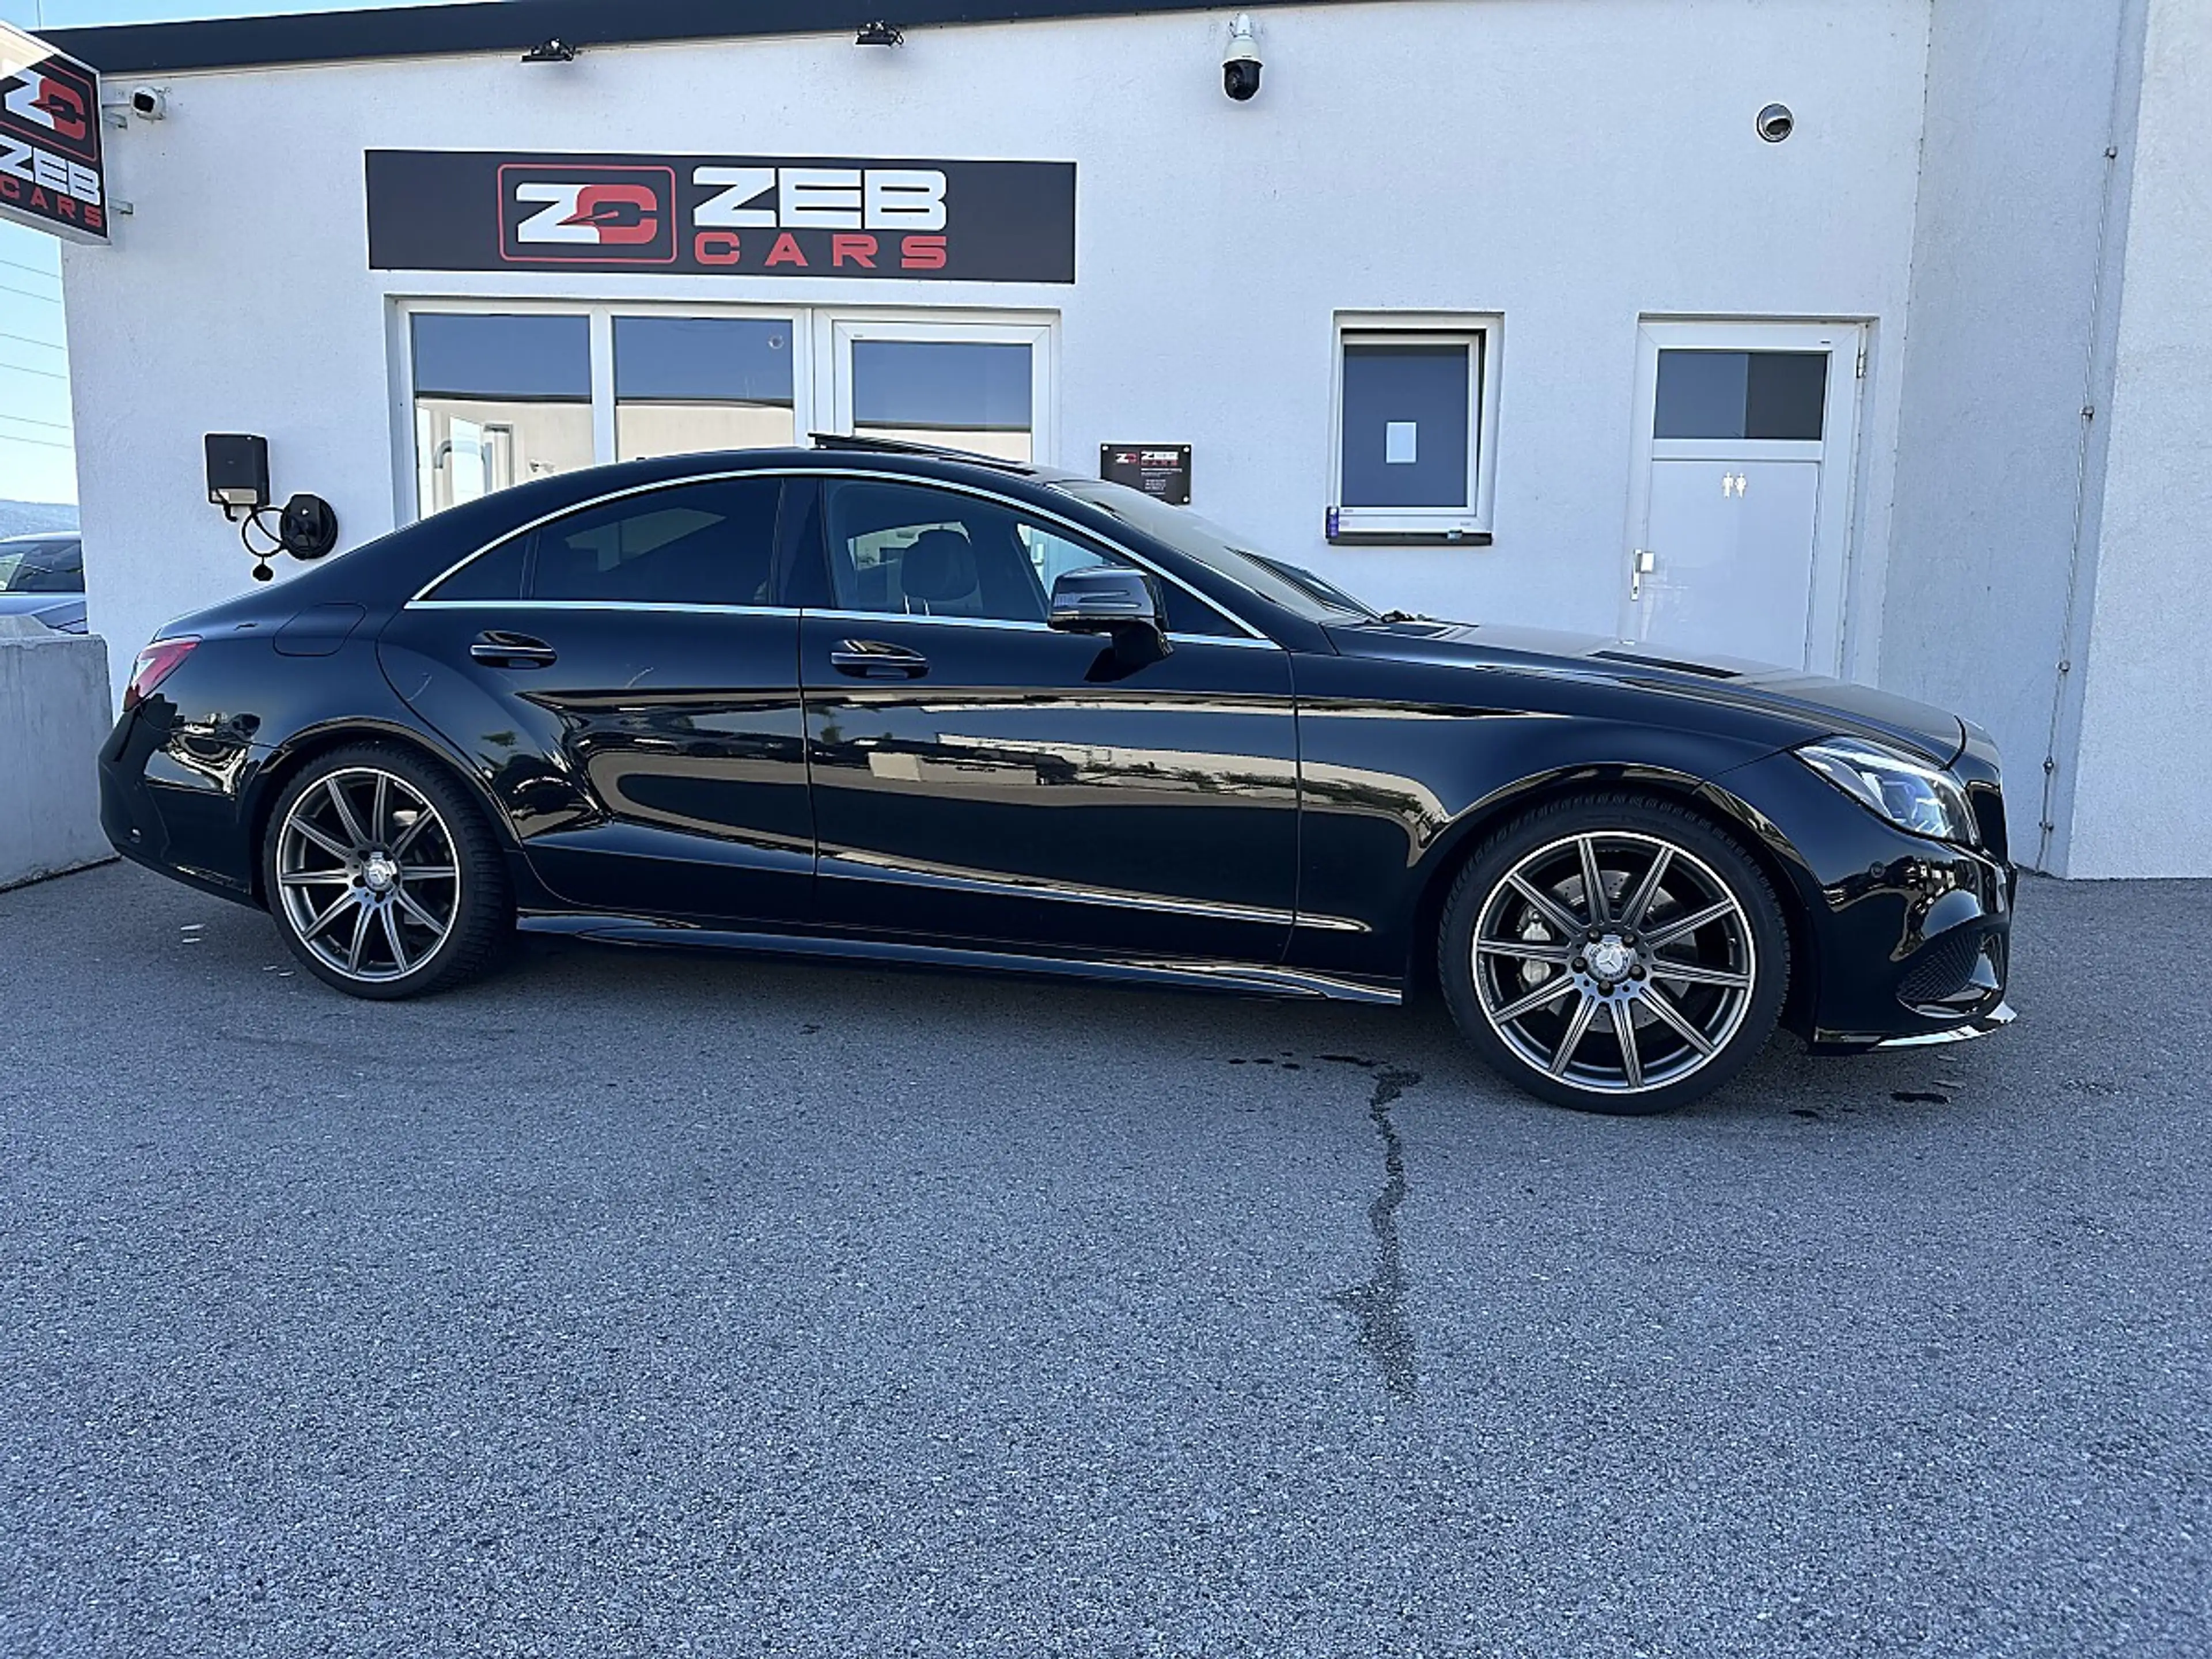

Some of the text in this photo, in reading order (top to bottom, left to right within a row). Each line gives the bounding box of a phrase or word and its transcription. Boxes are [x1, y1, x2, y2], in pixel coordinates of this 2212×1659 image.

[0, 132, 100, 206] ZEB
[693, 165, 947, 230] ZEB
[0, 176, 102, 228] CARS
[694, 232, 948, 269] CARS
